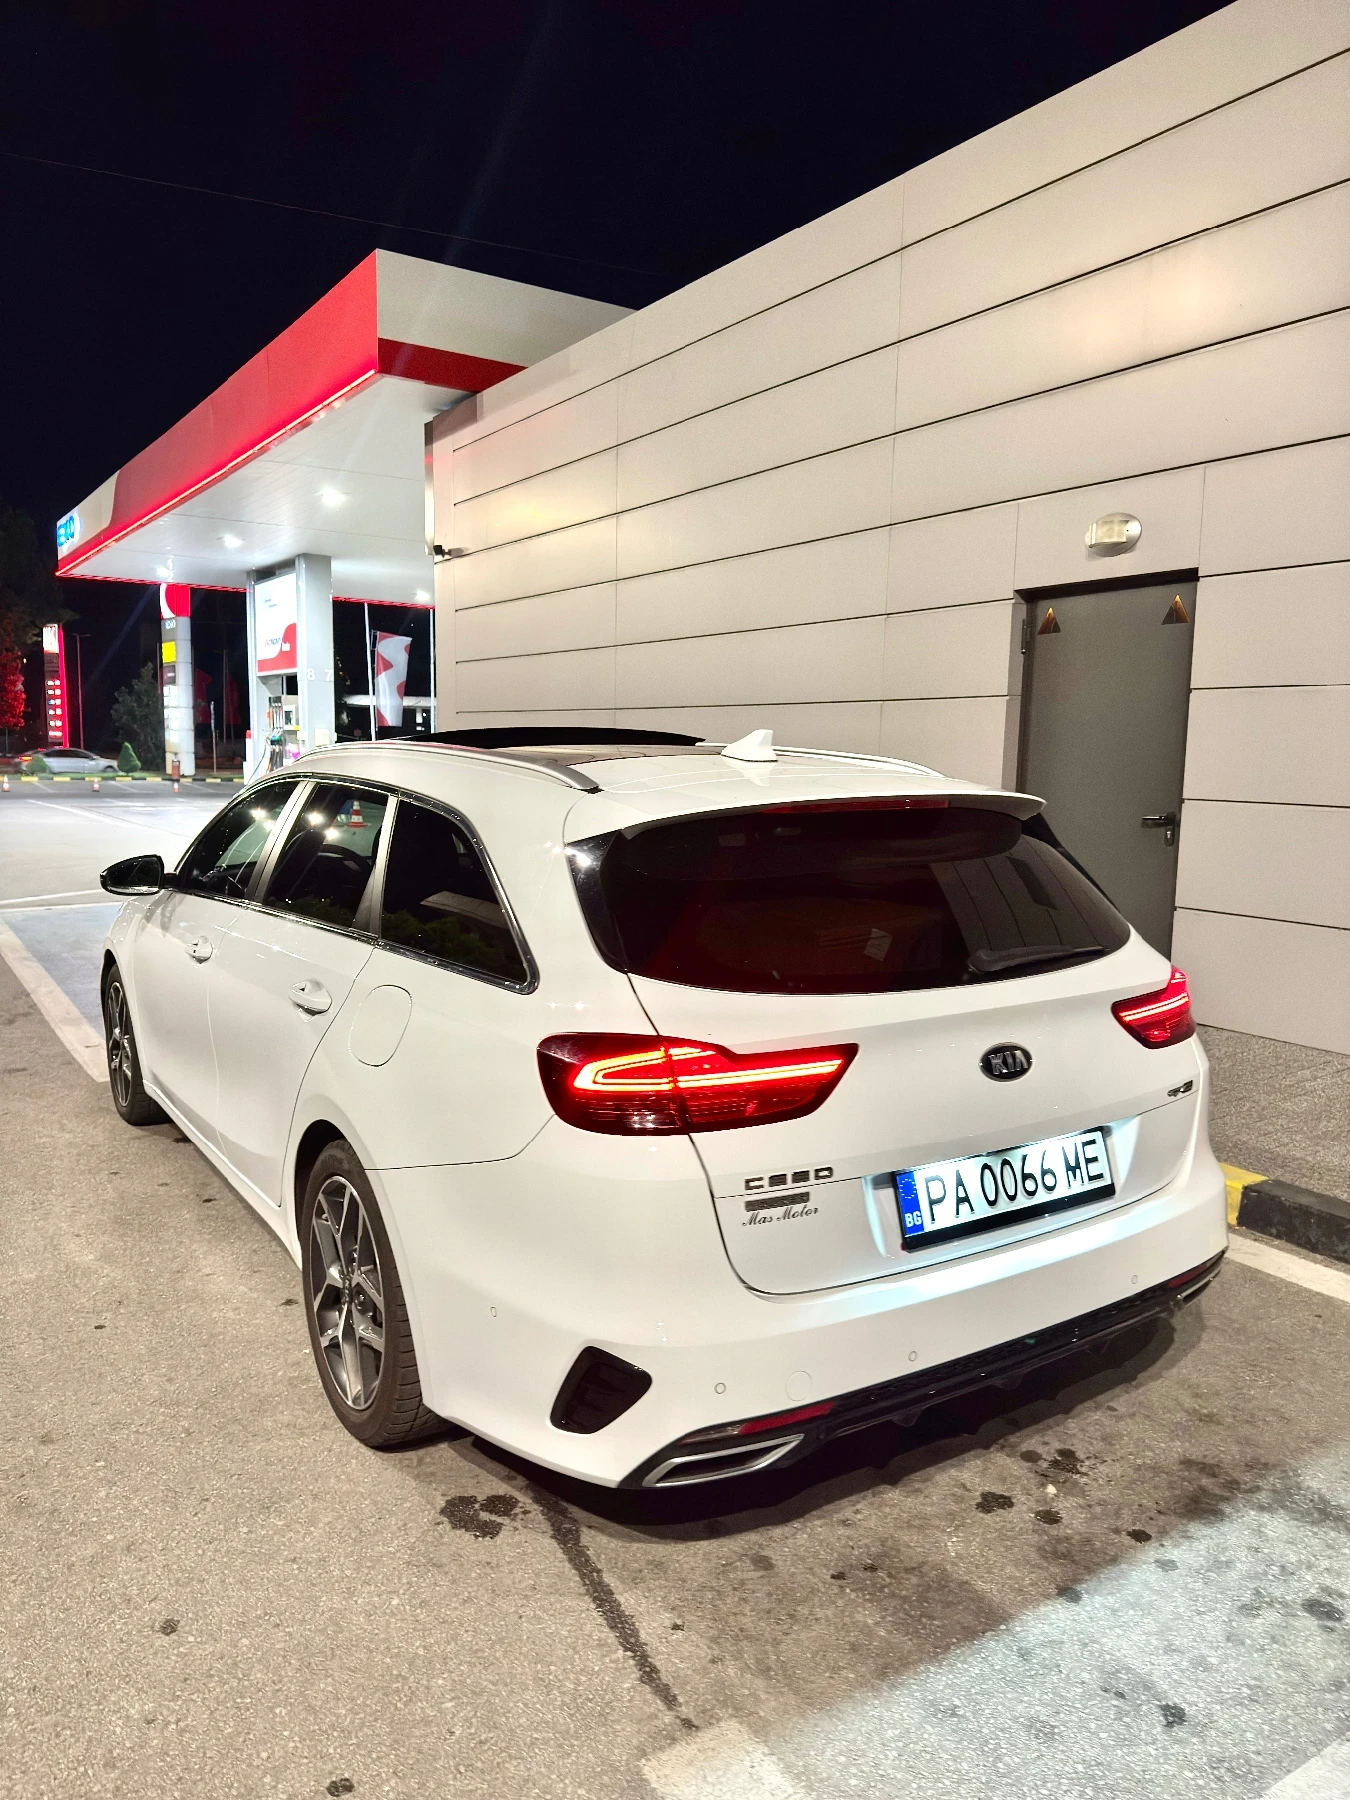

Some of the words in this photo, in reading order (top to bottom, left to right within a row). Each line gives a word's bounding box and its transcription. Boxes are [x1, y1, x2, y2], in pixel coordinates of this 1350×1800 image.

[307, 668, 316, 680] 8
[325, 669, 333, 681] 7
[988, 1050, 1029, 1075] KIA
[924, 1169, 976, 1224] PA
[980, 1149, 1057, 1207] 0066
[1061, 1138, 1104, 1189] ME
[742, 1211, 773, 1226] Mas
[776, 1204, 819, 1222] Motor
[904, 1210, 923, 1228] BG
